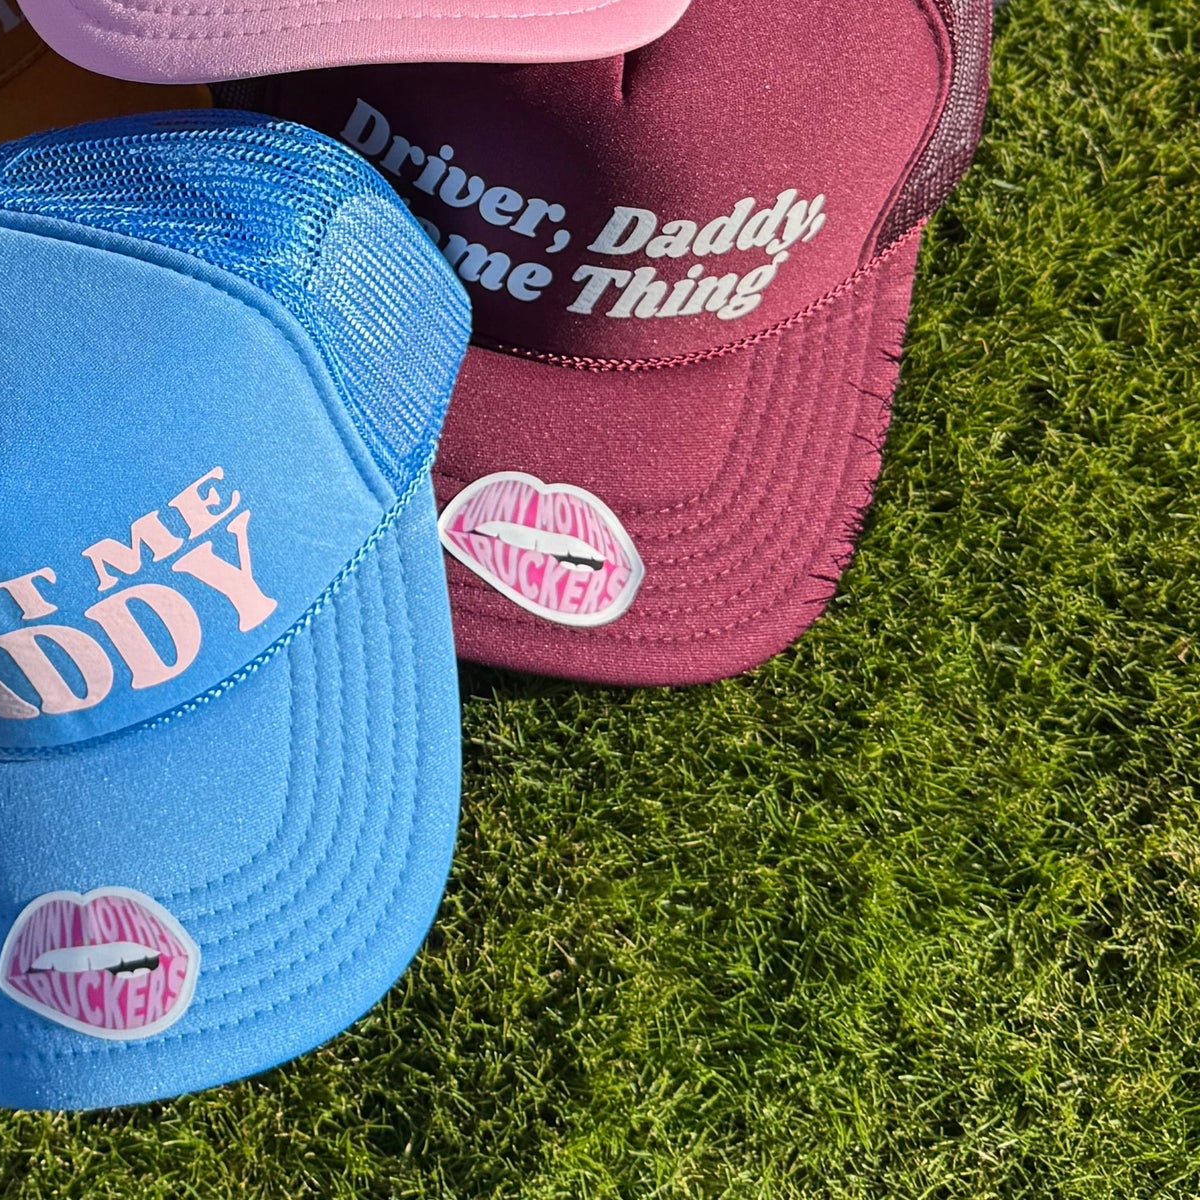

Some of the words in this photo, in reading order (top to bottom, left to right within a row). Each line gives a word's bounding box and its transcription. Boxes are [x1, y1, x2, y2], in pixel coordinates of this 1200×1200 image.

[340, 97, 571, 254] Driver,
[587, 188, 827, 261] Daddy,
[566, 250, 789, 320] Thing
[81, 465, 242, 592] ME
